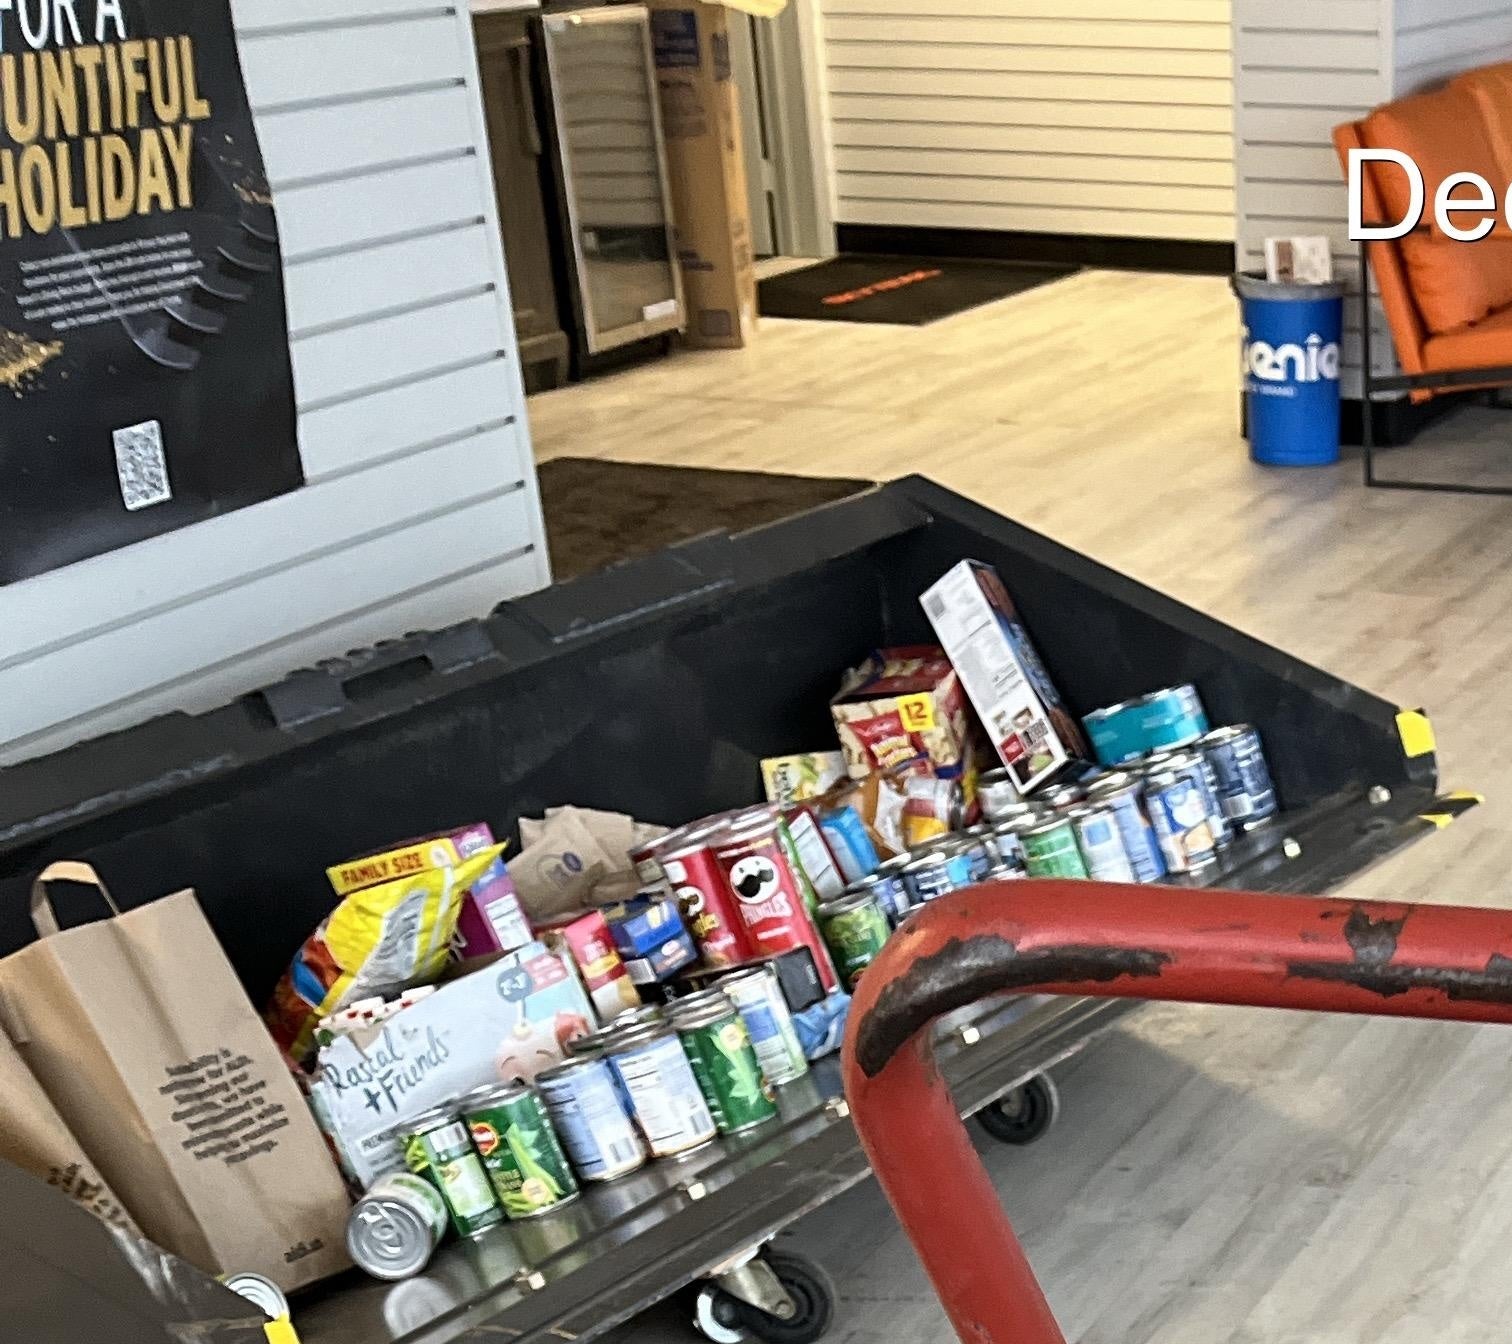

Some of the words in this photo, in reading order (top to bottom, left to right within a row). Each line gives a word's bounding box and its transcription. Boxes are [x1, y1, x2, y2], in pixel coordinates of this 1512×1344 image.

[1242, 331, 1339, 382] enie
[905, 701, 928, 721] 12
[341, 861, 389, 885] FAMILY
[392, 853, 424, 875] SIZE
